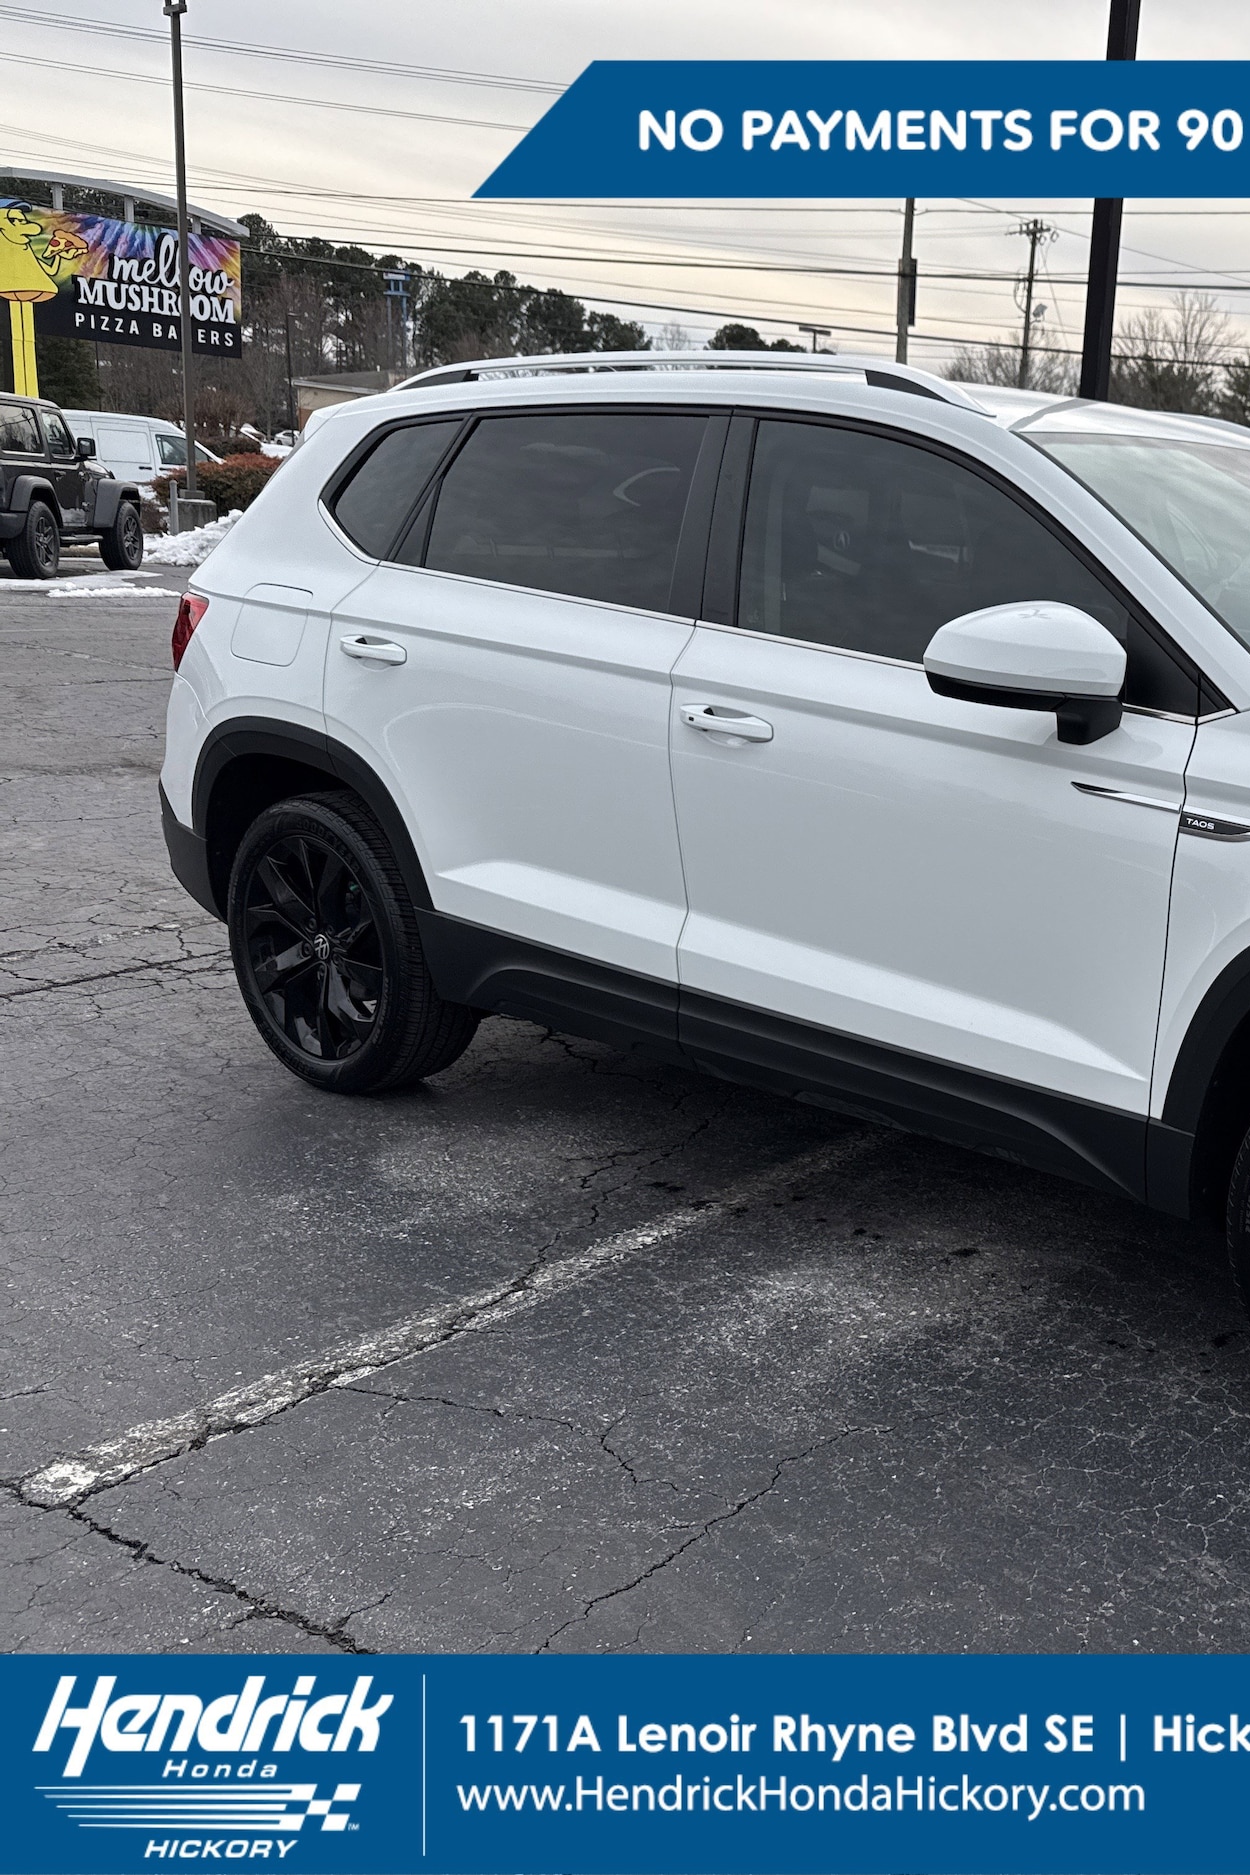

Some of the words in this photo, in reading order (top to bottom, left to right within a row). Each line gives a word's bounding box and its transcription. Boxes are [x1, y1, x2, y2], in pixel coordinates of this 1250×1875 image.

[77, 276, 236, 324] MUSHROM
[74, 312, 140, 335] PIZZA
[152, 322, 233, 347] BAERS
[1186, 817, 1215, 830] TAOS
